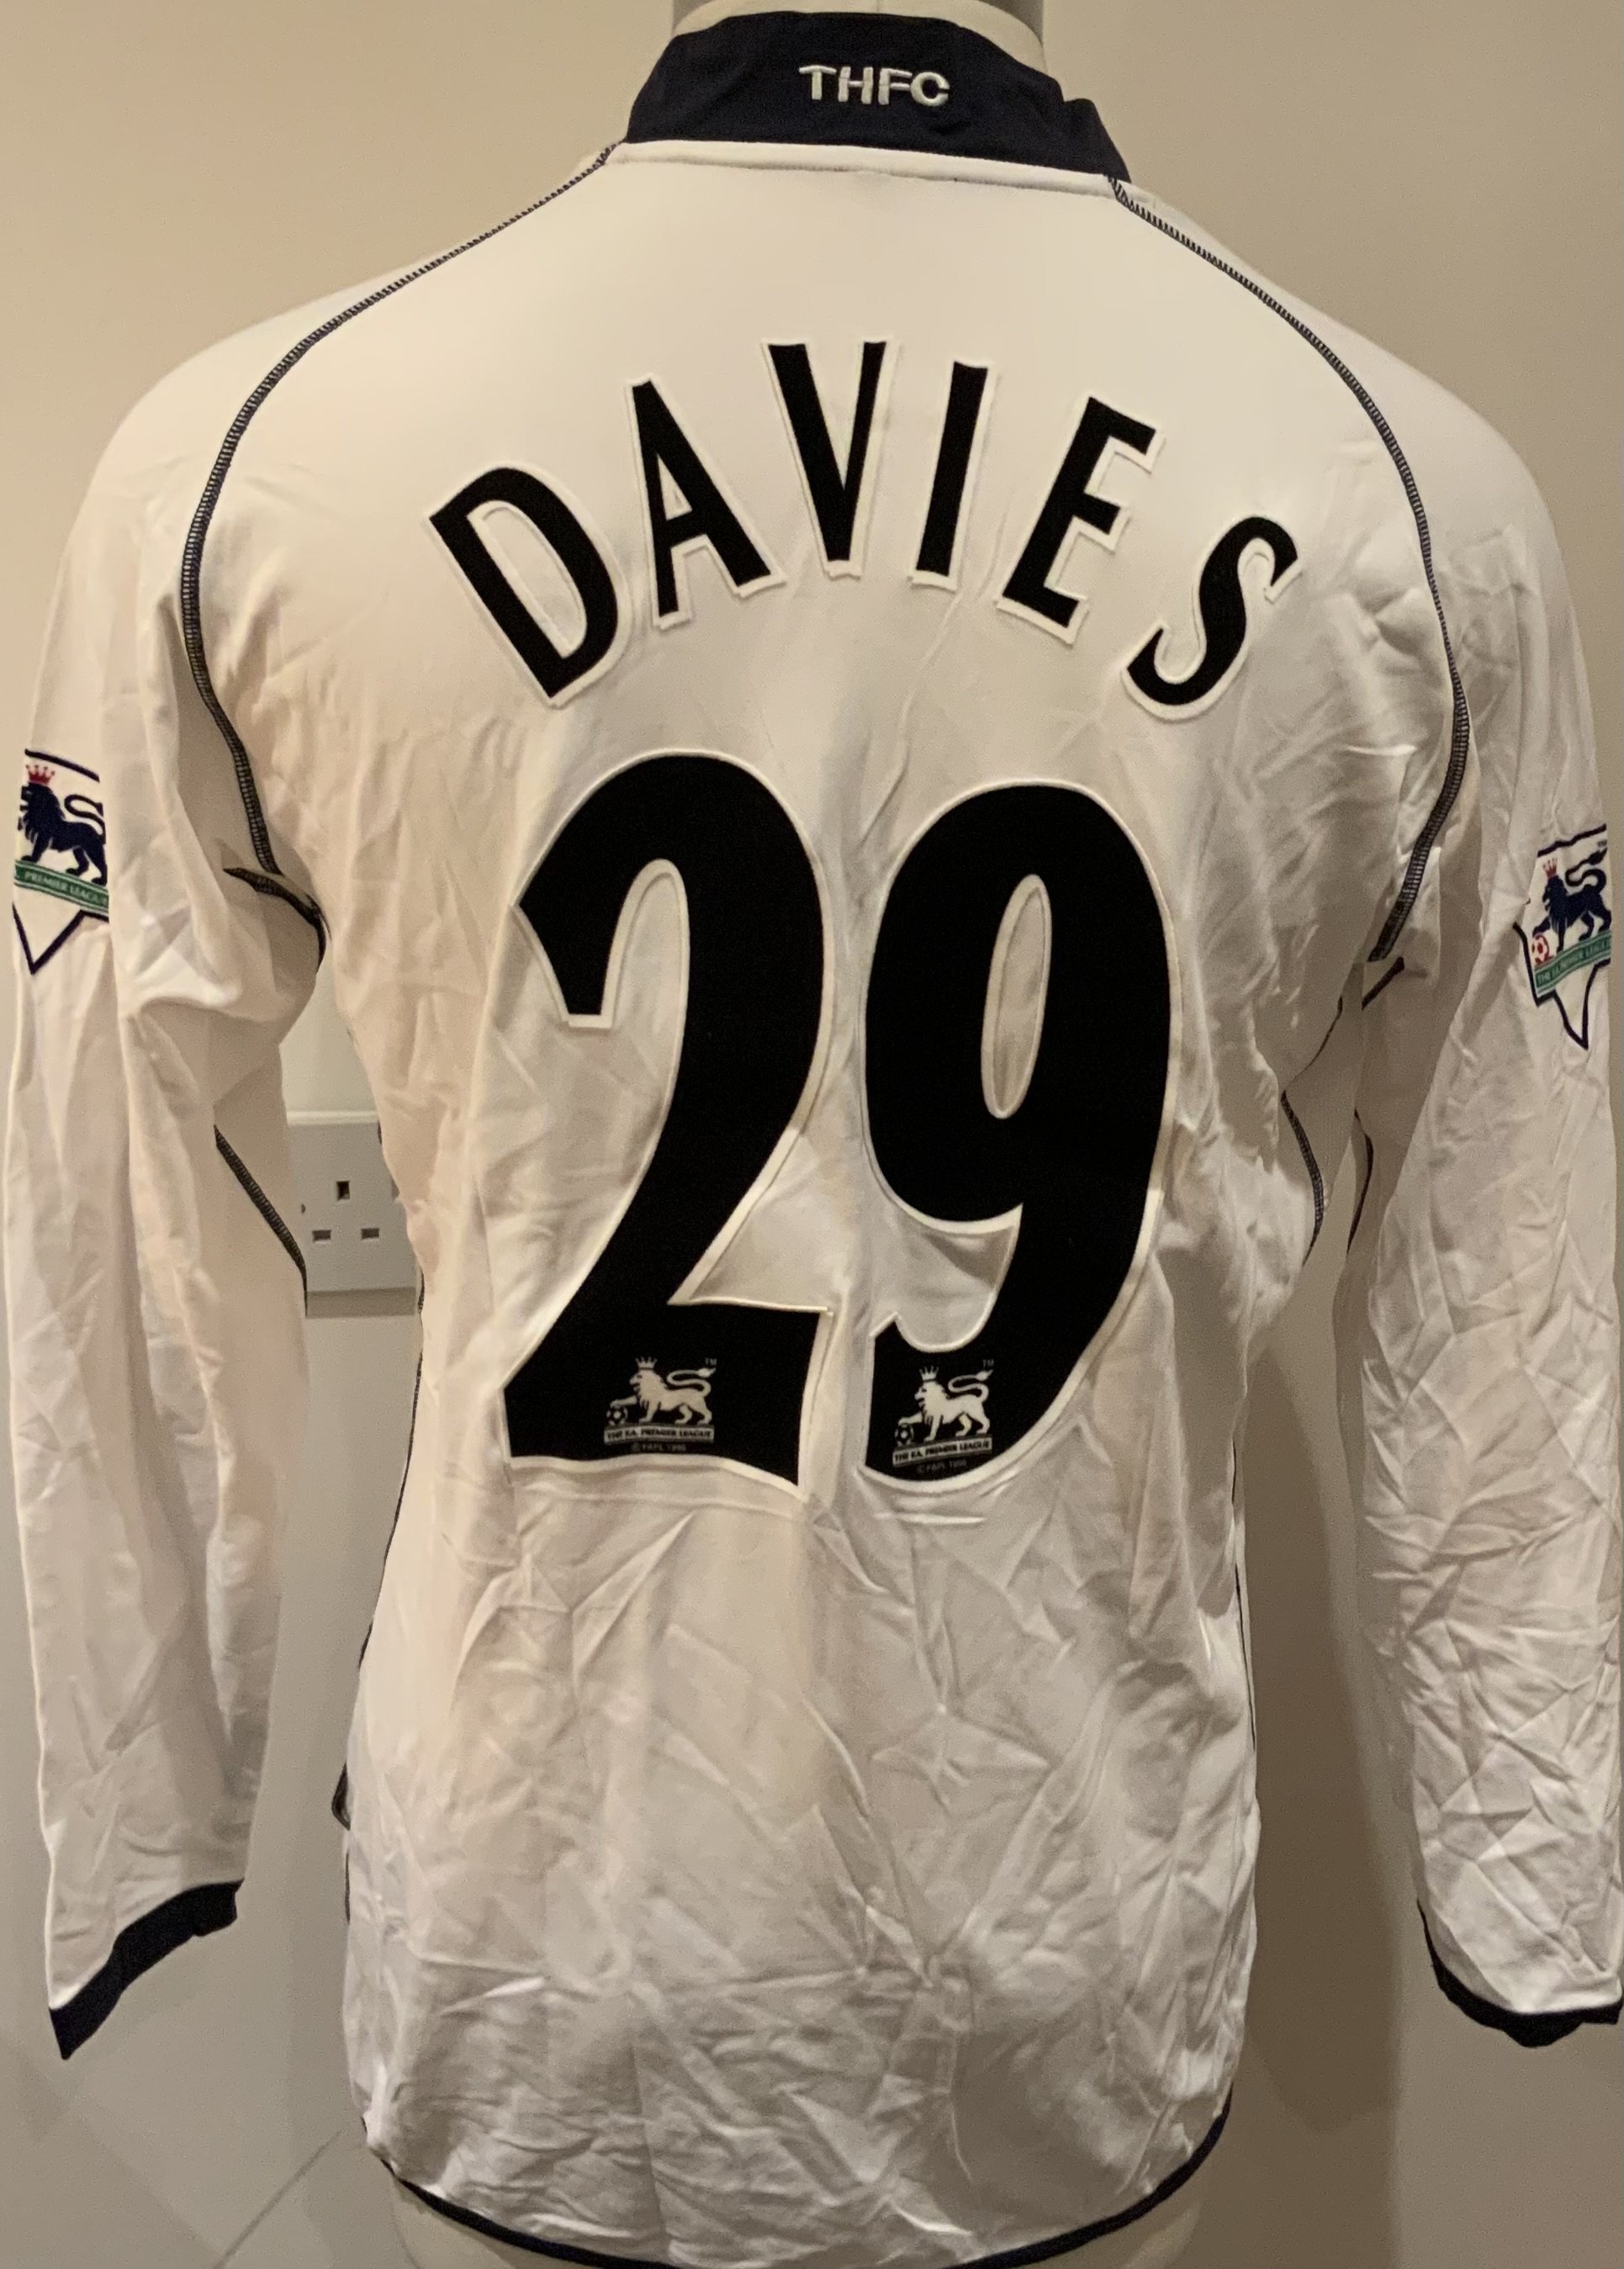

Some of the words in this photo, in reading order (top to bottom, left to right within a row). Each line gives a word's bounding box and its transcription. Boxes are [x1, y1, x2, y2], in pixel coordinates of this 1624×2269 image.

[798, 64, 950, 107] THFC
[428, 341, 1299, 706] DAVIES
[502, 754, 1172, 1487] 29
[606, 1431, 623, 1440] THE
[641, 1429, 677, 1437] PREMIER
[679, 1430, 711, 1438] LEAGUE
[894, 1452, 909, 1462] THE
[925, 1444, 958, 1456] PREMIER
[959, 1440, 990, 1450] LEAGUE
